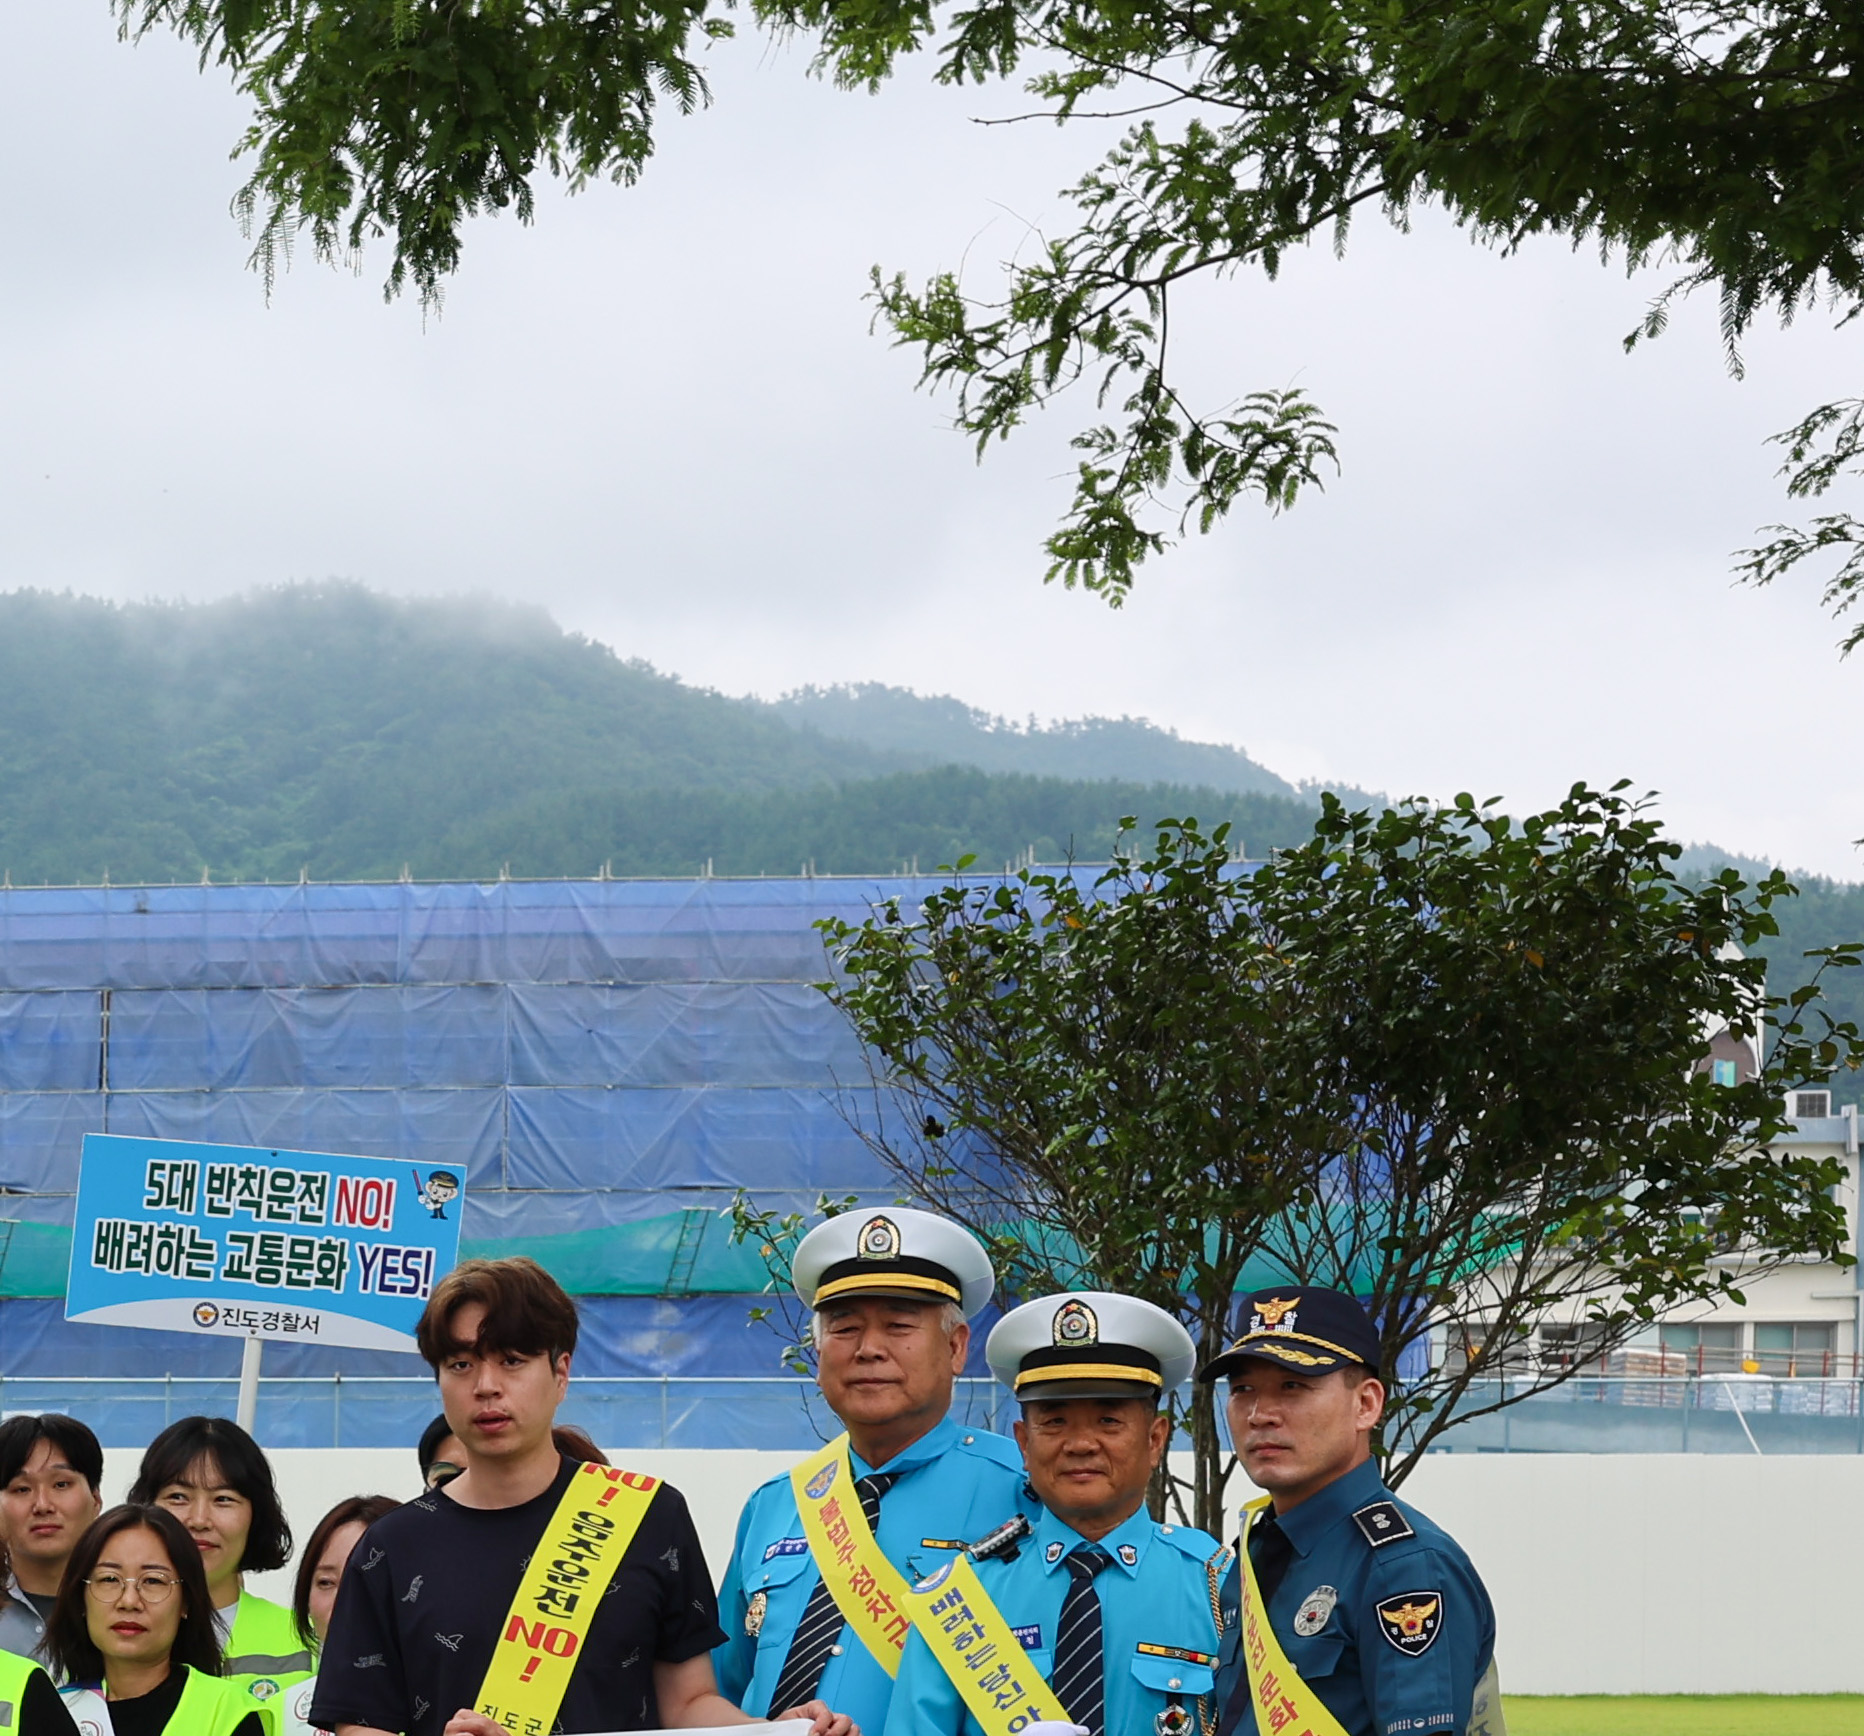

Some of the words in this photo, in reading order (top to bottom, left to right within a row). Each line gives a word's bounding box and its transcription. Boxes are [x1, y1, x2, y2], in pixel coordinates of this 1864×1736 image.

[147, 1161, 196, 1212] 5대
[207, 1165, 327, 1222] 반칙운전
[335, 1178, 394, 1229] NO!
[94, 1220, 215, 1278] 배려하는
[224, 1232, 347, 1291] 교통문화
[359, 1245, 433, 1298] YES!
[222, 1308, 320, 1334] 진도경찰서
[533, 1510, 615, 1620] 음주운전
[503, 1614, 580, 1684] NO!
[929, 1587, 999, 1671] 배려하는
[978, 1660, 1028, 1713] 당신
[1400, 1632, 1428, 1644] POLICE
